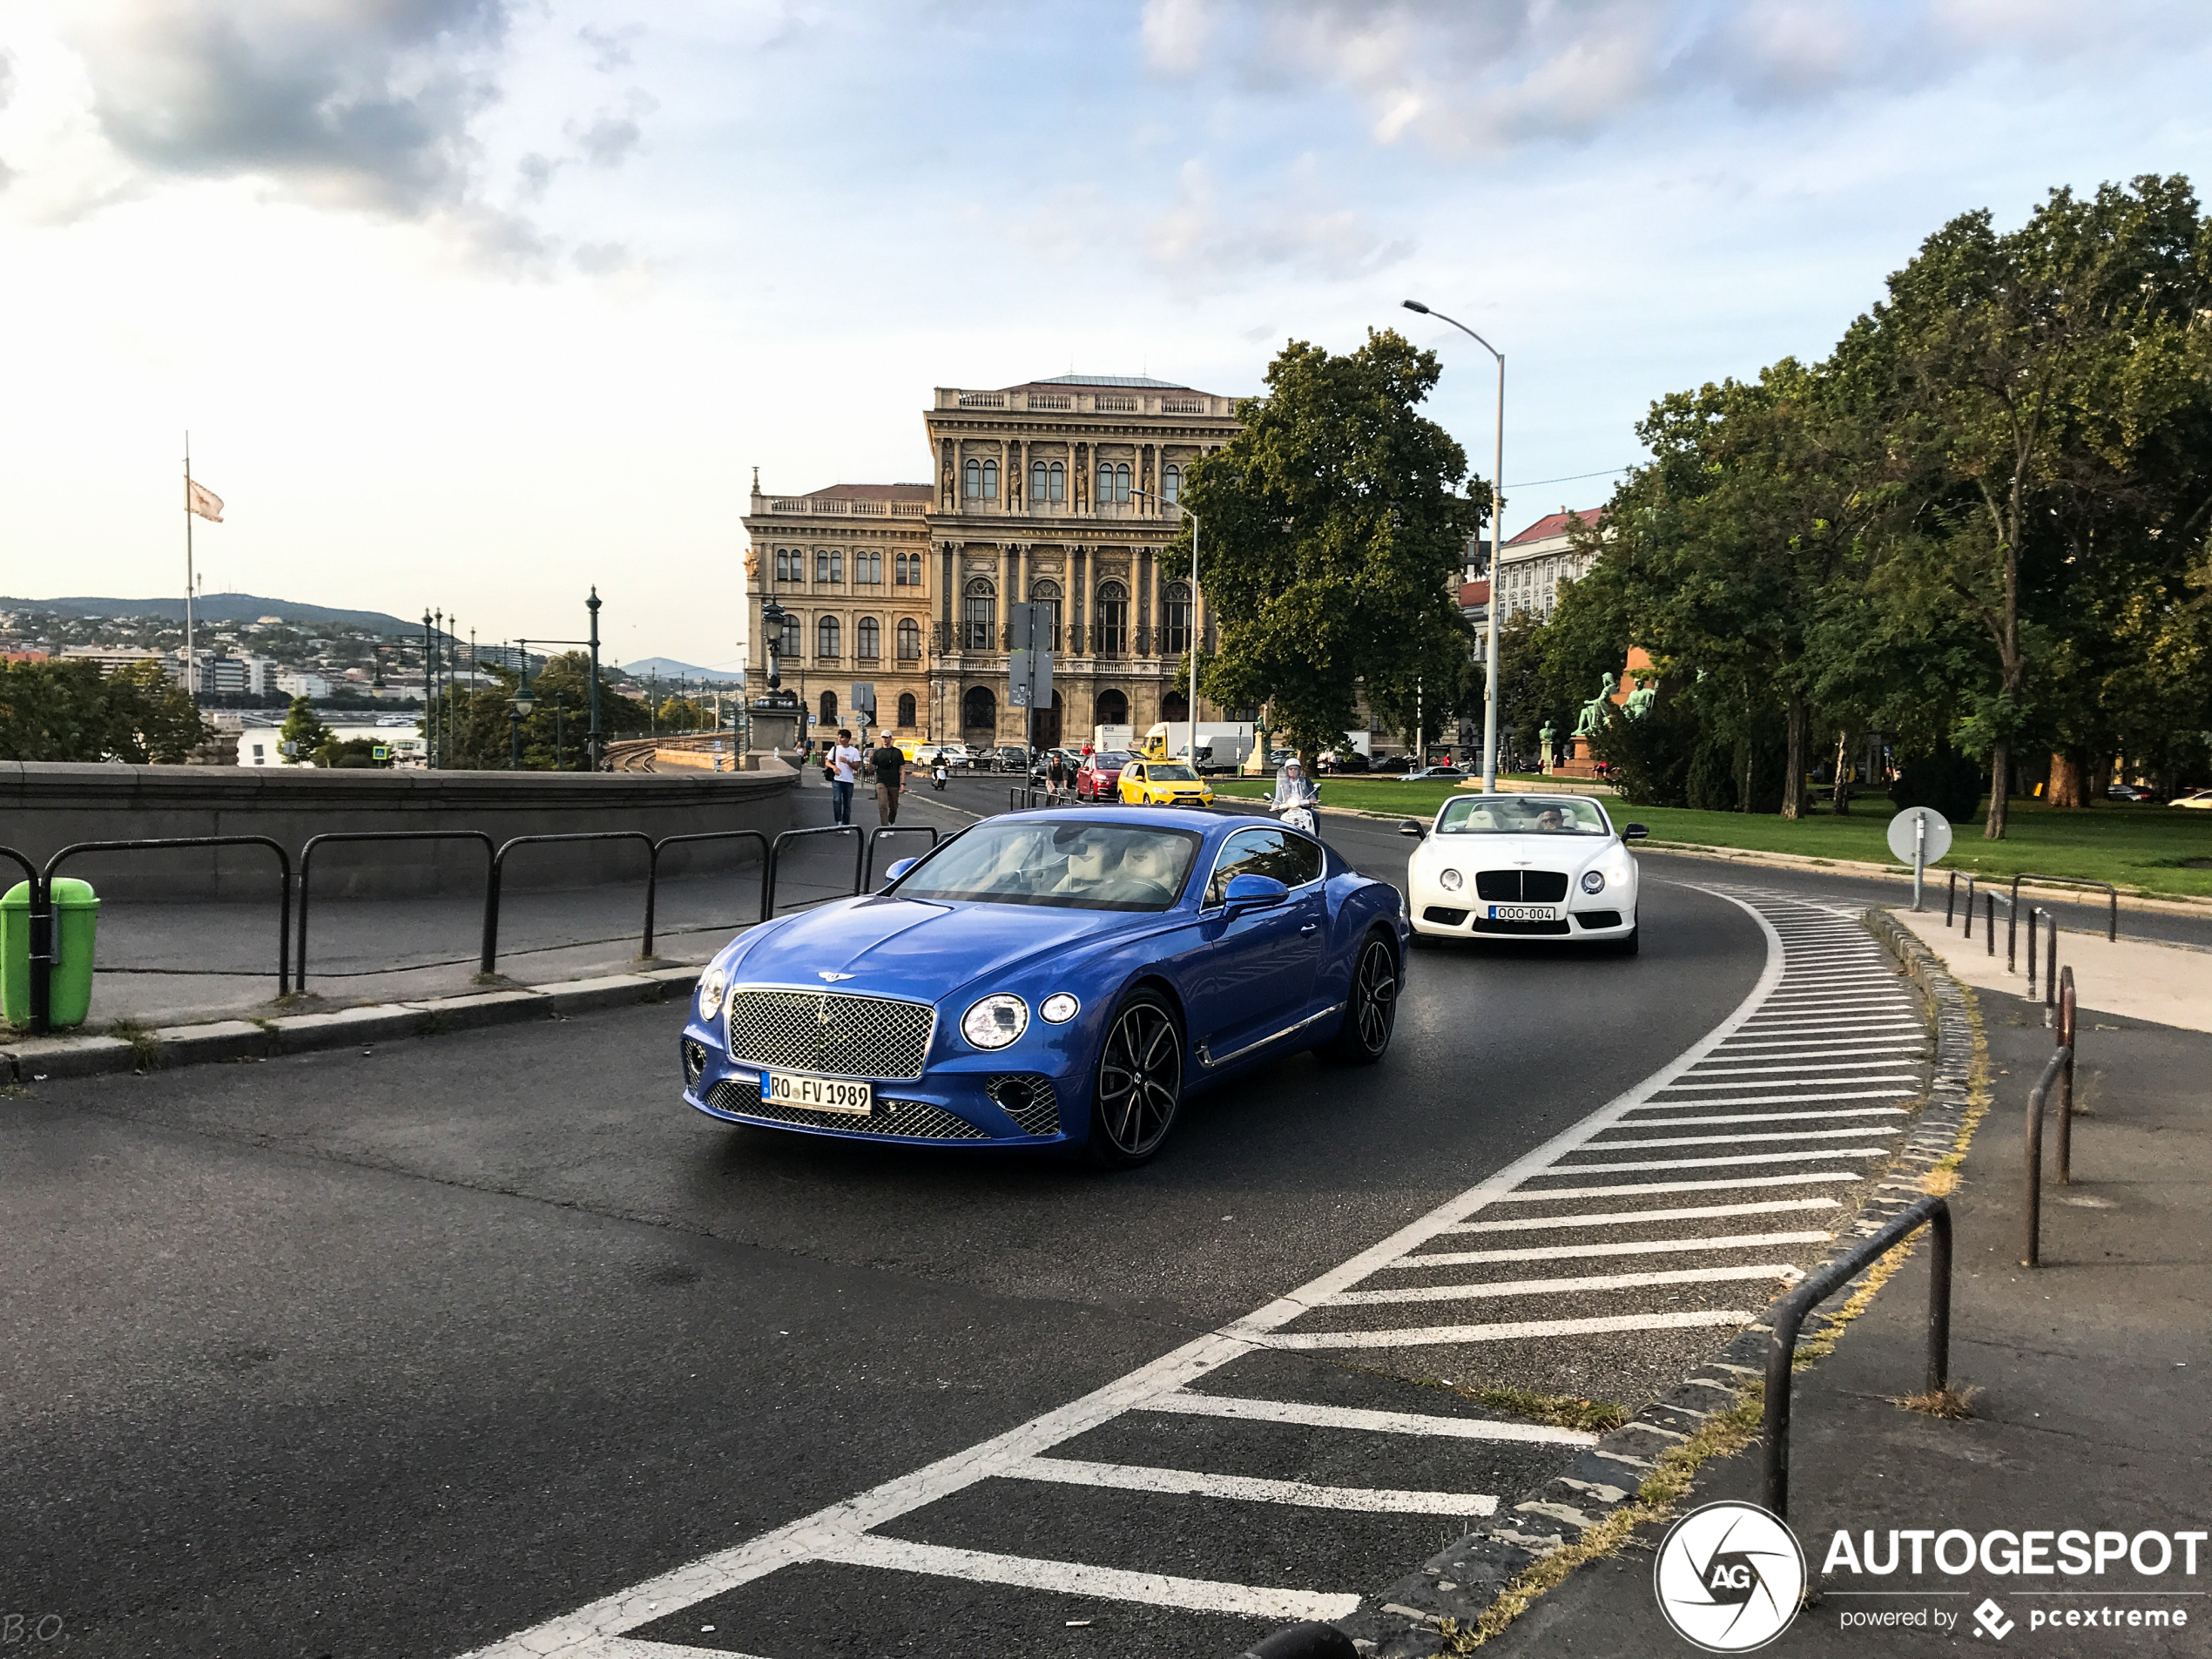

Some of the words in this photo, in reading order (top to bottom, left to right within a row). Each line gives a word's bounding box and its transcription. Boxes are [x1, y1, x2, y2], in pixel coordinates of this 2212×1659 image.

[771, 1076, 791, 1098] RO
[802, 1081, 822, 1103] FV
[826, 1083, 868, 1108] 1989
